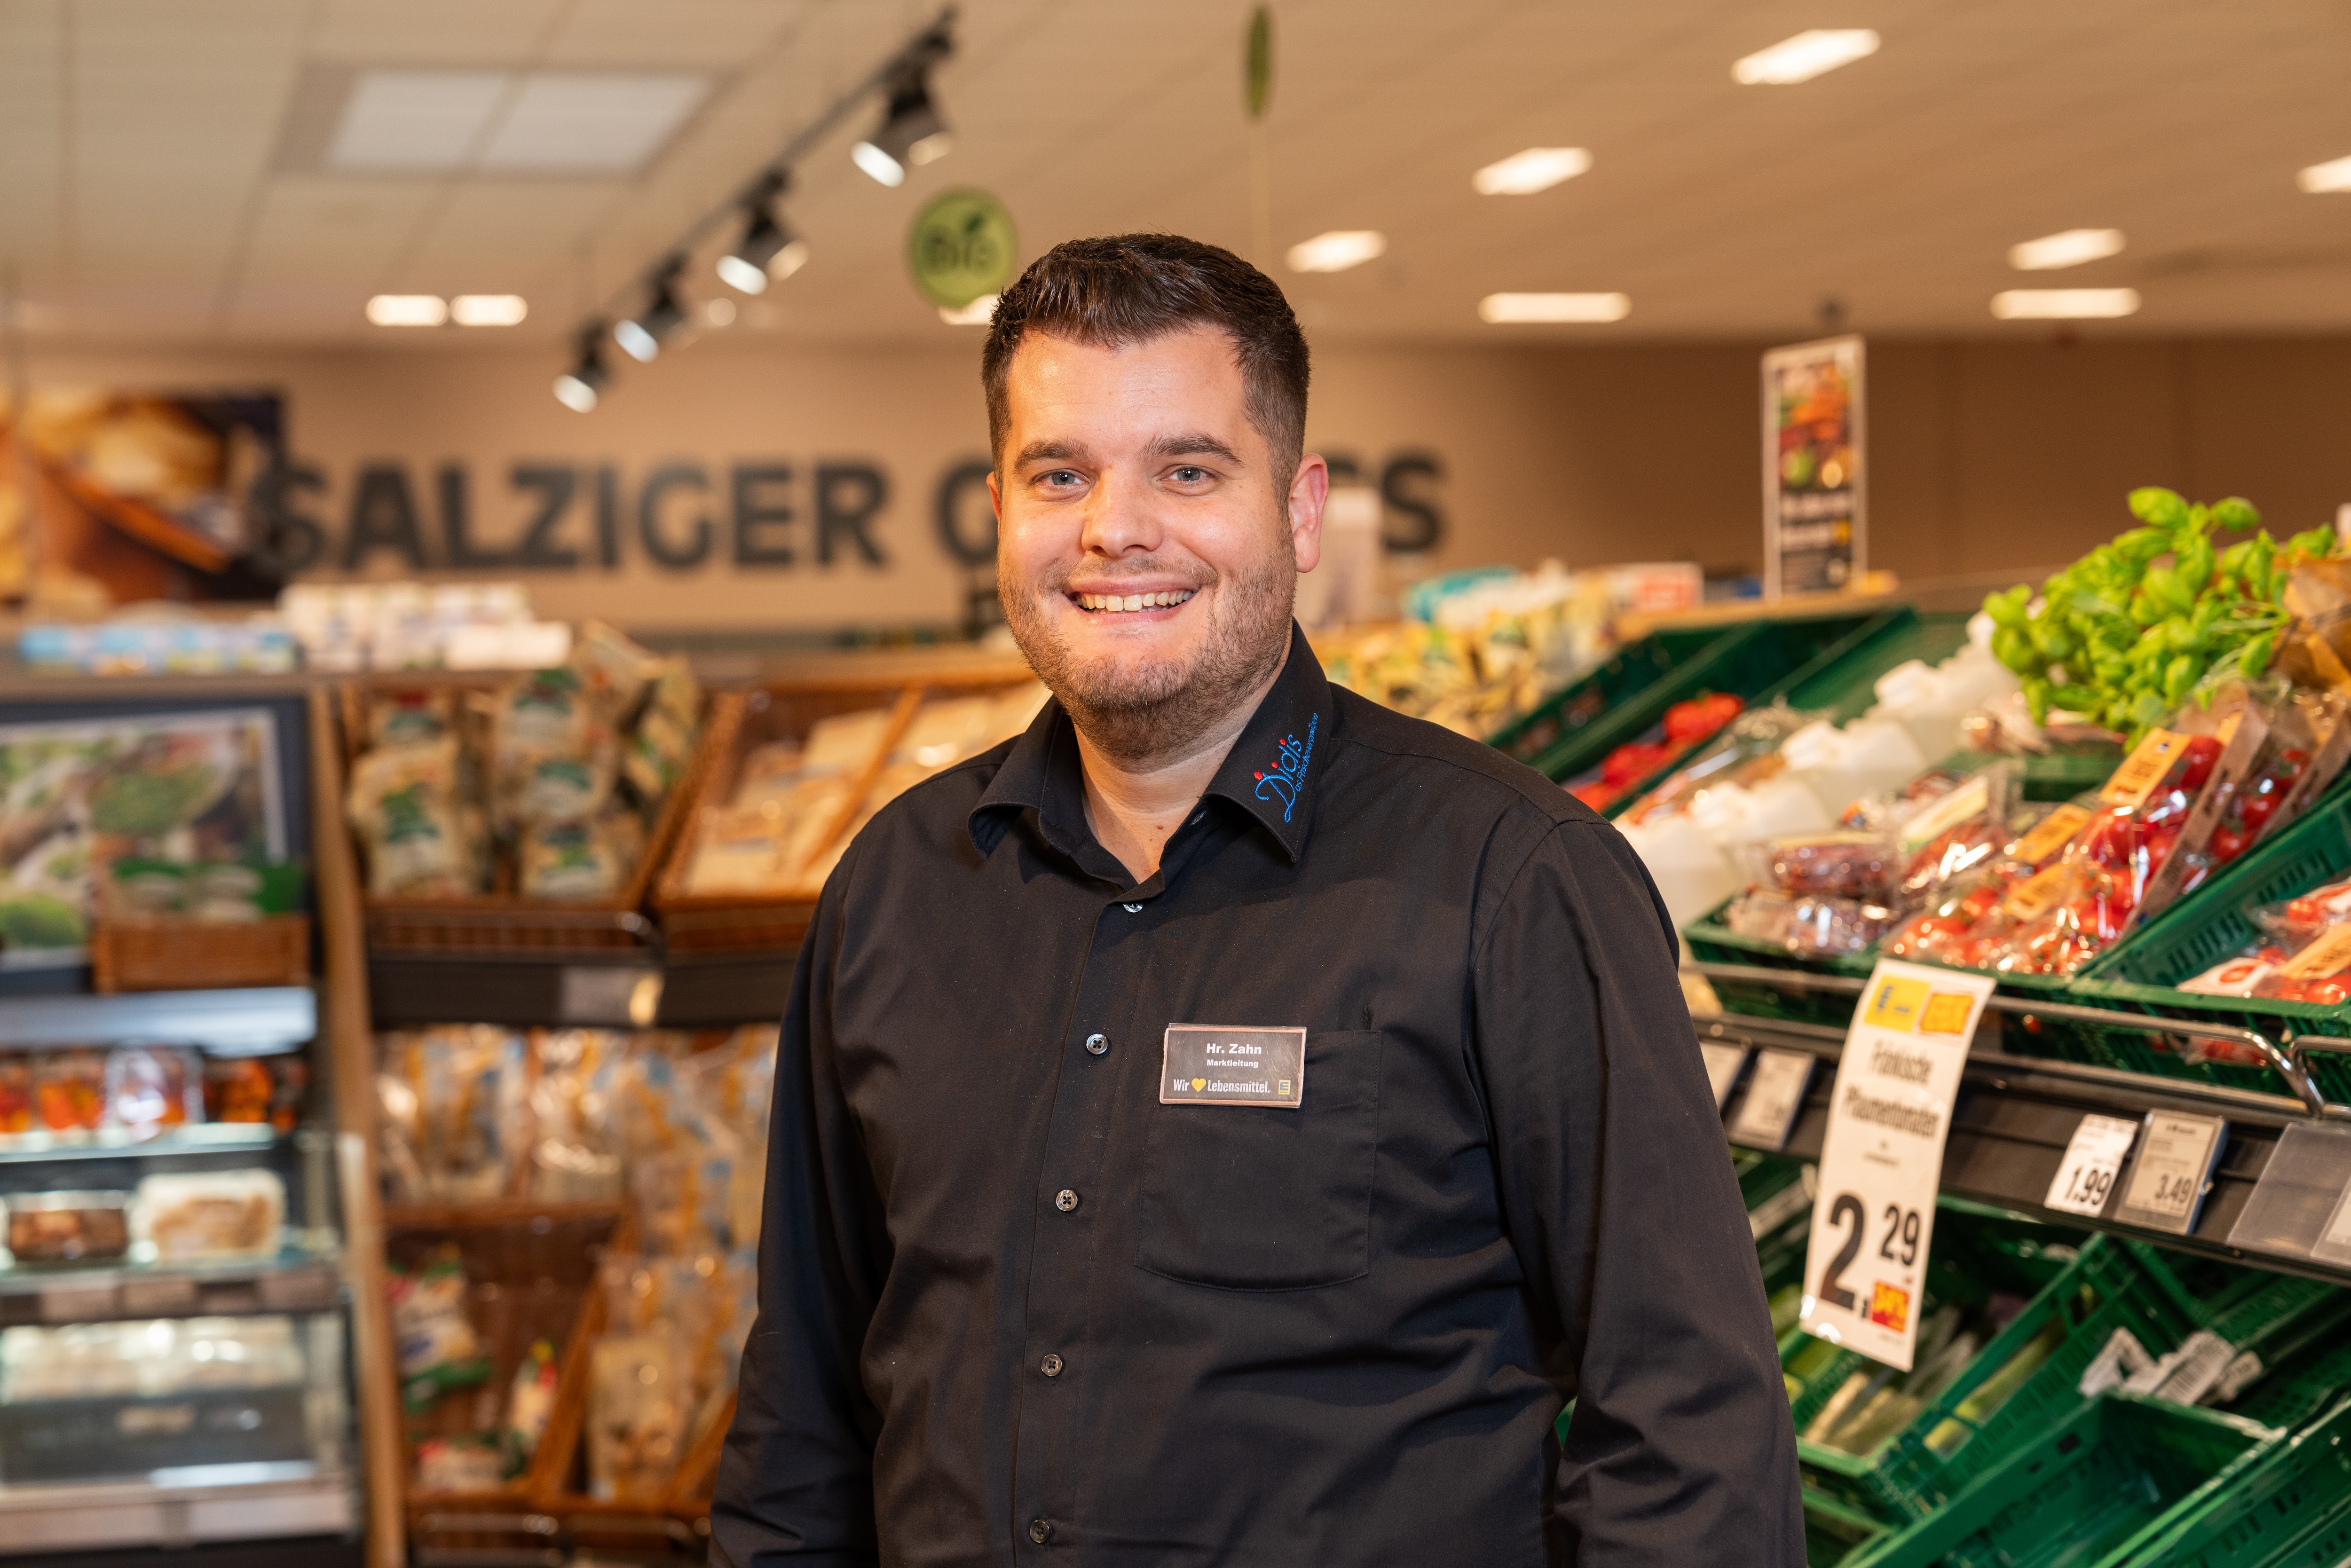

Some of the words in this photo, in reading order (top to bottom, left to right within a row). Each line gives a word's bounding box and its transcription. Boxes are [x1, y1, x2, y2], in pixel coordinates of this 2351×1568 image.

[254, 459, 890, 571] SALZIGER
[1254, 734, 1302, 823] Didis
[1206, 1043, 1225, 1054] Hr.
[1229, 1044, 1262, 1055] Zahn
[1207, 1059, 1259, 1069] Marktleitung
[1173, 1079, 1190, 1092] Wir
[1207, 1080, 1270, 1093] Lebensmittel.
[2064, 1166, 2111, 1207] 1.99
[2154, 1173, 2193, 1205] 3.49
